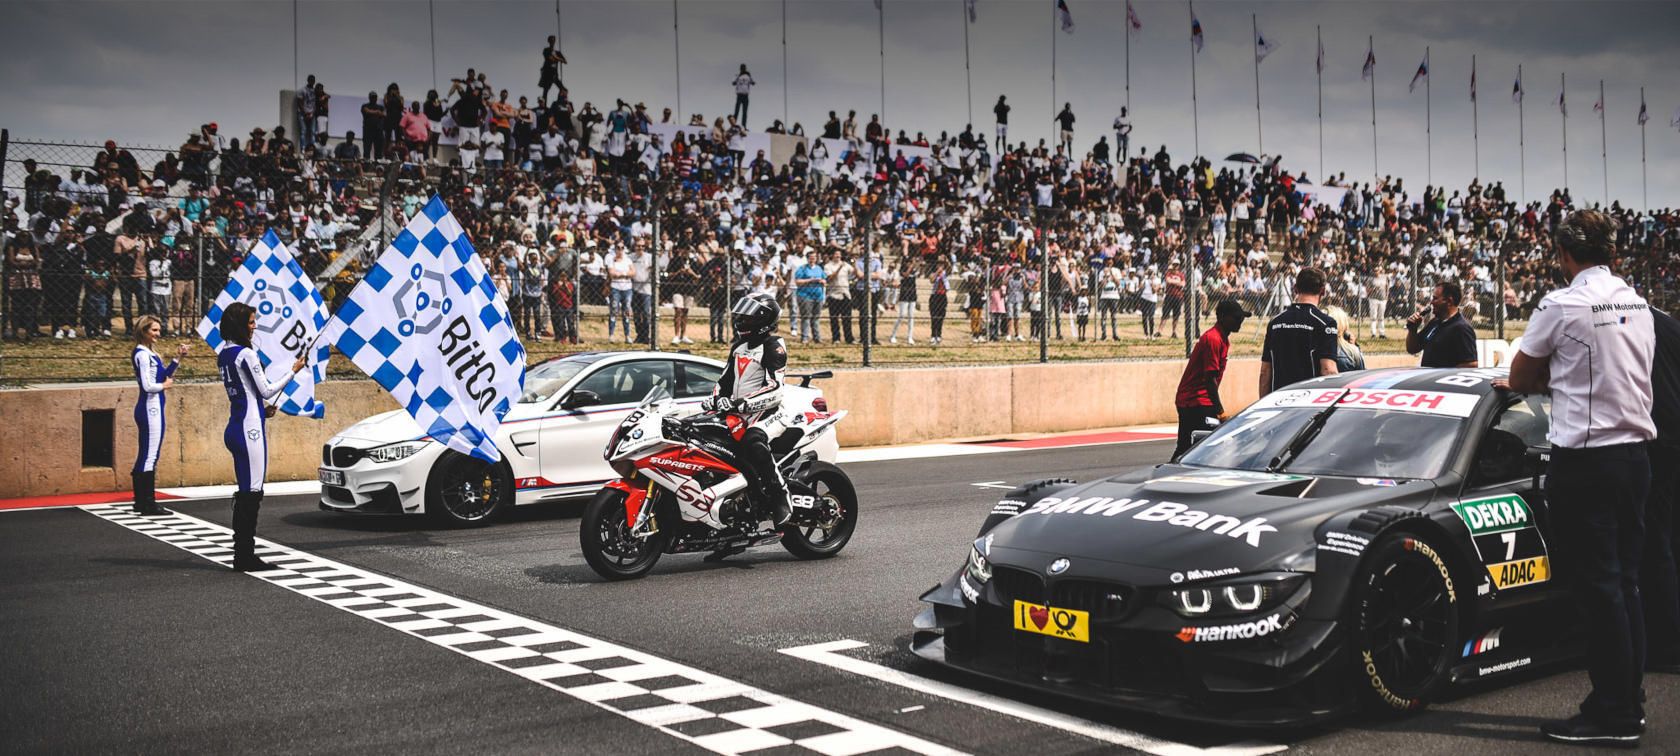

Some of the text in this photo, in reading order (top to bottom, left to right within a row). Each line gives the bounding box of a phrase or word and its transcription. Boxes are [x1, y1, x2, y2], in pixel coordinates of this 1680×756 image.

[1592, 304, 1613, 313] BMW
[437, 314, 497, 415] BitCo
[1312, 390, 1445, 410] BOSCH
[649, 456, 706, 472] SUPABETS
[791, 494, 815, 509] 38
[1463, 501, 1528, 529] DEKRA
[1014, 497, 1279, 548] BMW Bank
[1500, 532, 1516, 560] 7
[1499, 559, 1536, 587] ADAC
